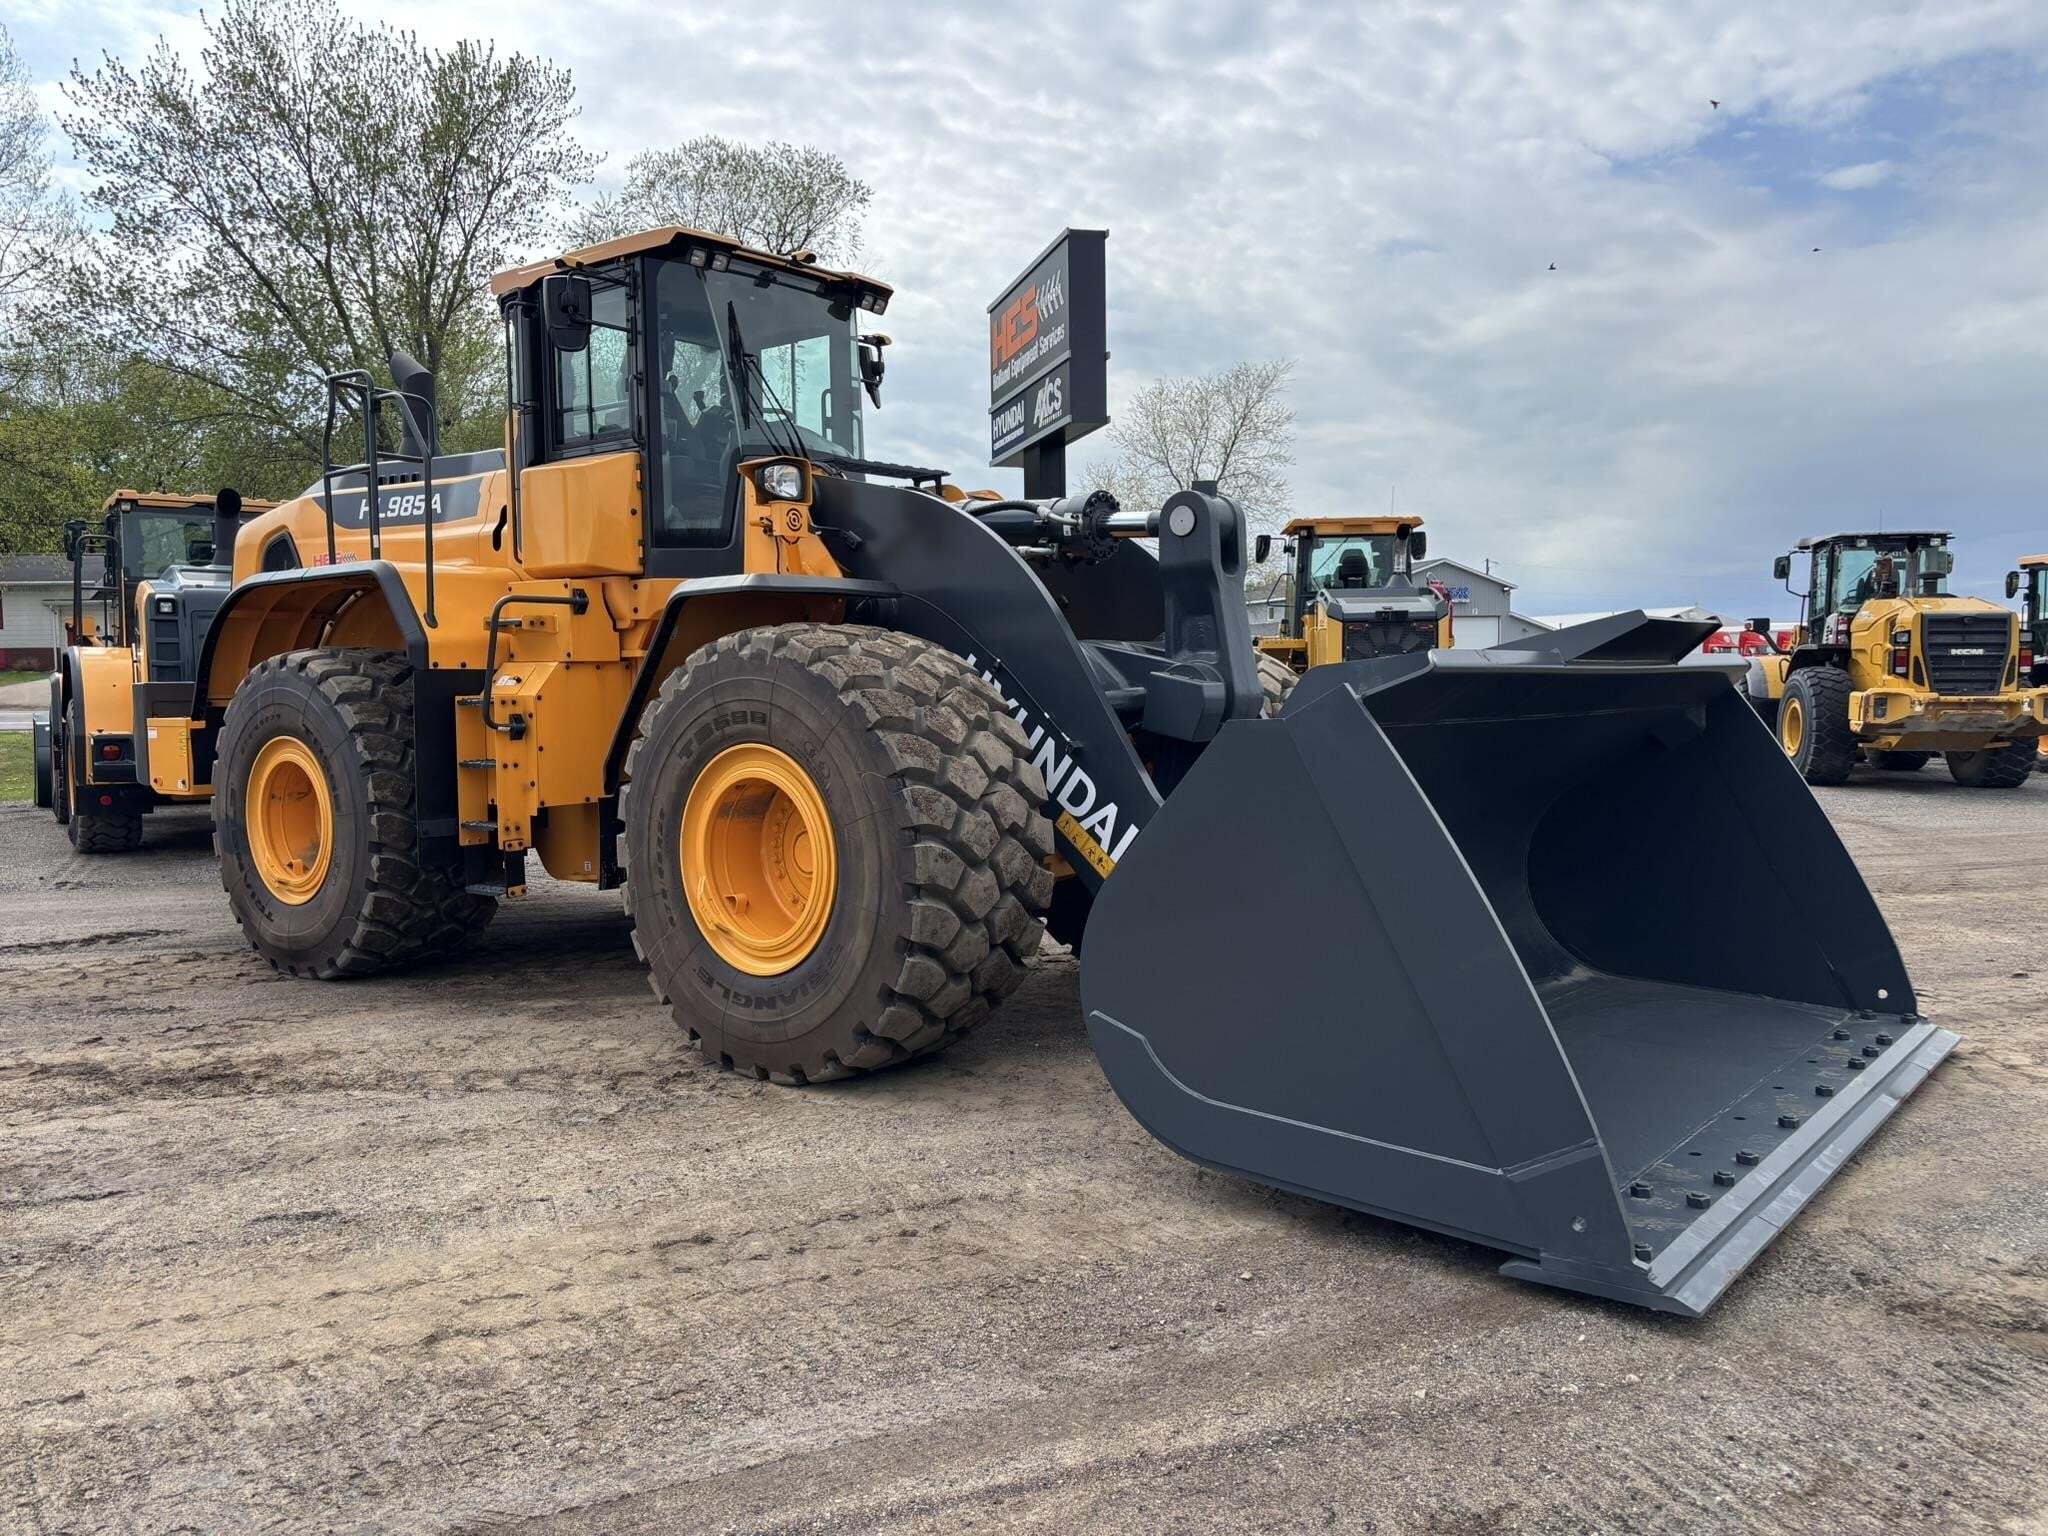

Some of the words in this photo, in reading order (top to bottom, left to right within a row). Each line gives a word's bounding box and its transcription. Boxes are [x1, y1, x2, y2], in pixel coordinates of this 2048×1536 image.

[992, 285, 1039, 371] HES
[1039, 323, 1065, 356] Services
[992, 400, 1025, 440] HYUNDAI
[966, 653, 1140, 864] NDAI
